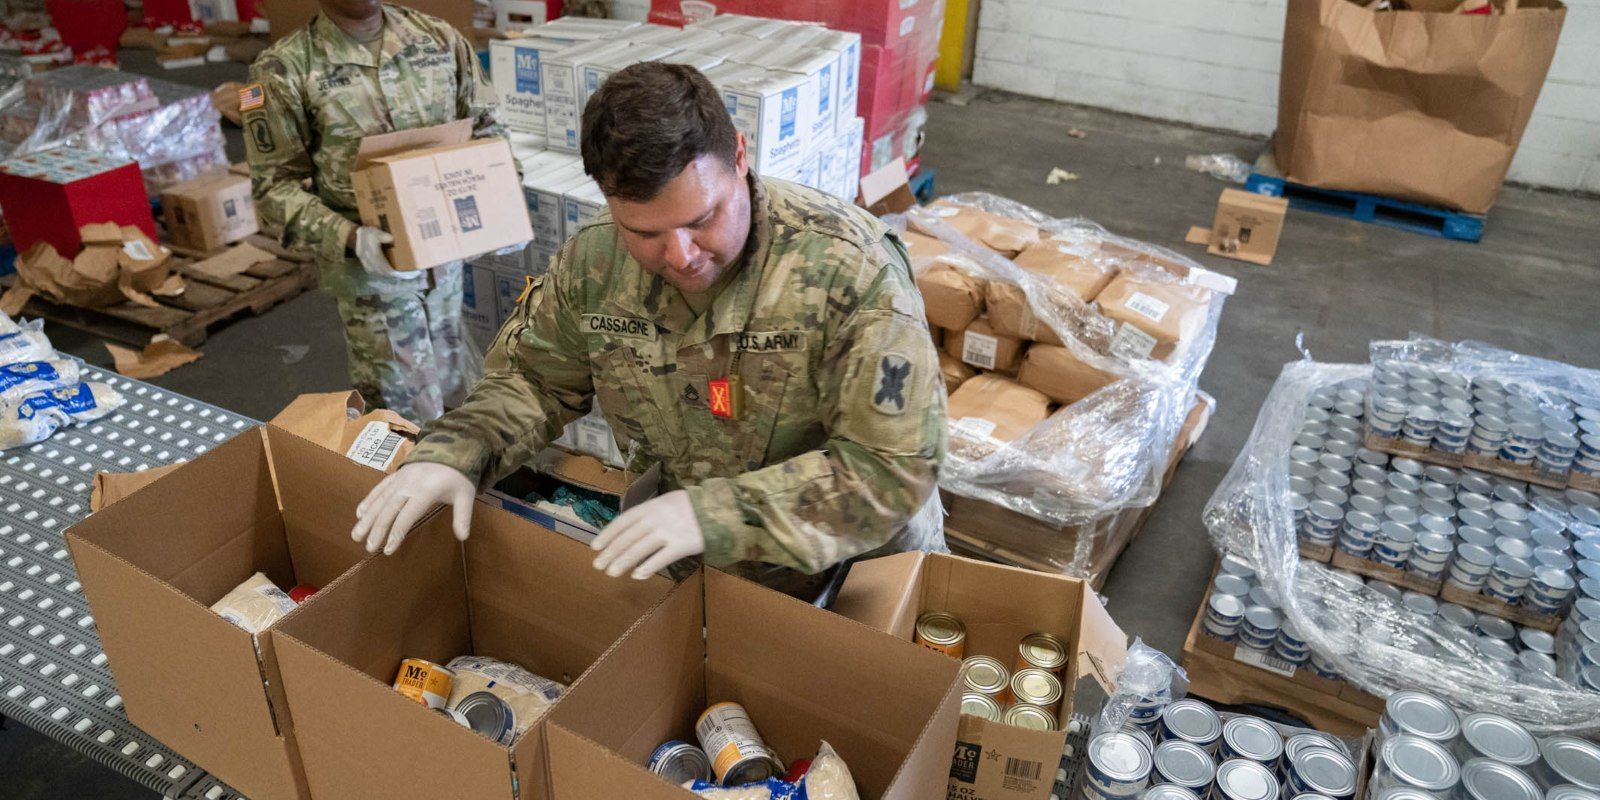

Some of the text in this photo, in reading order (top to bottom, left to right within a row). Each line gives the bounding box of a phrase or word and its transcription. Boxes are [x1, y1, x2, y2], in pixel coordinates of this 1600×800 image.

[505, 94, 545, 109] Spaghe
[590, 316, 649, 336] CASSAGNE
[764, 334, 799, 350] ARMY
[361, 438, 382, 459] Rice
[960, 787, 976, 796] OZ
